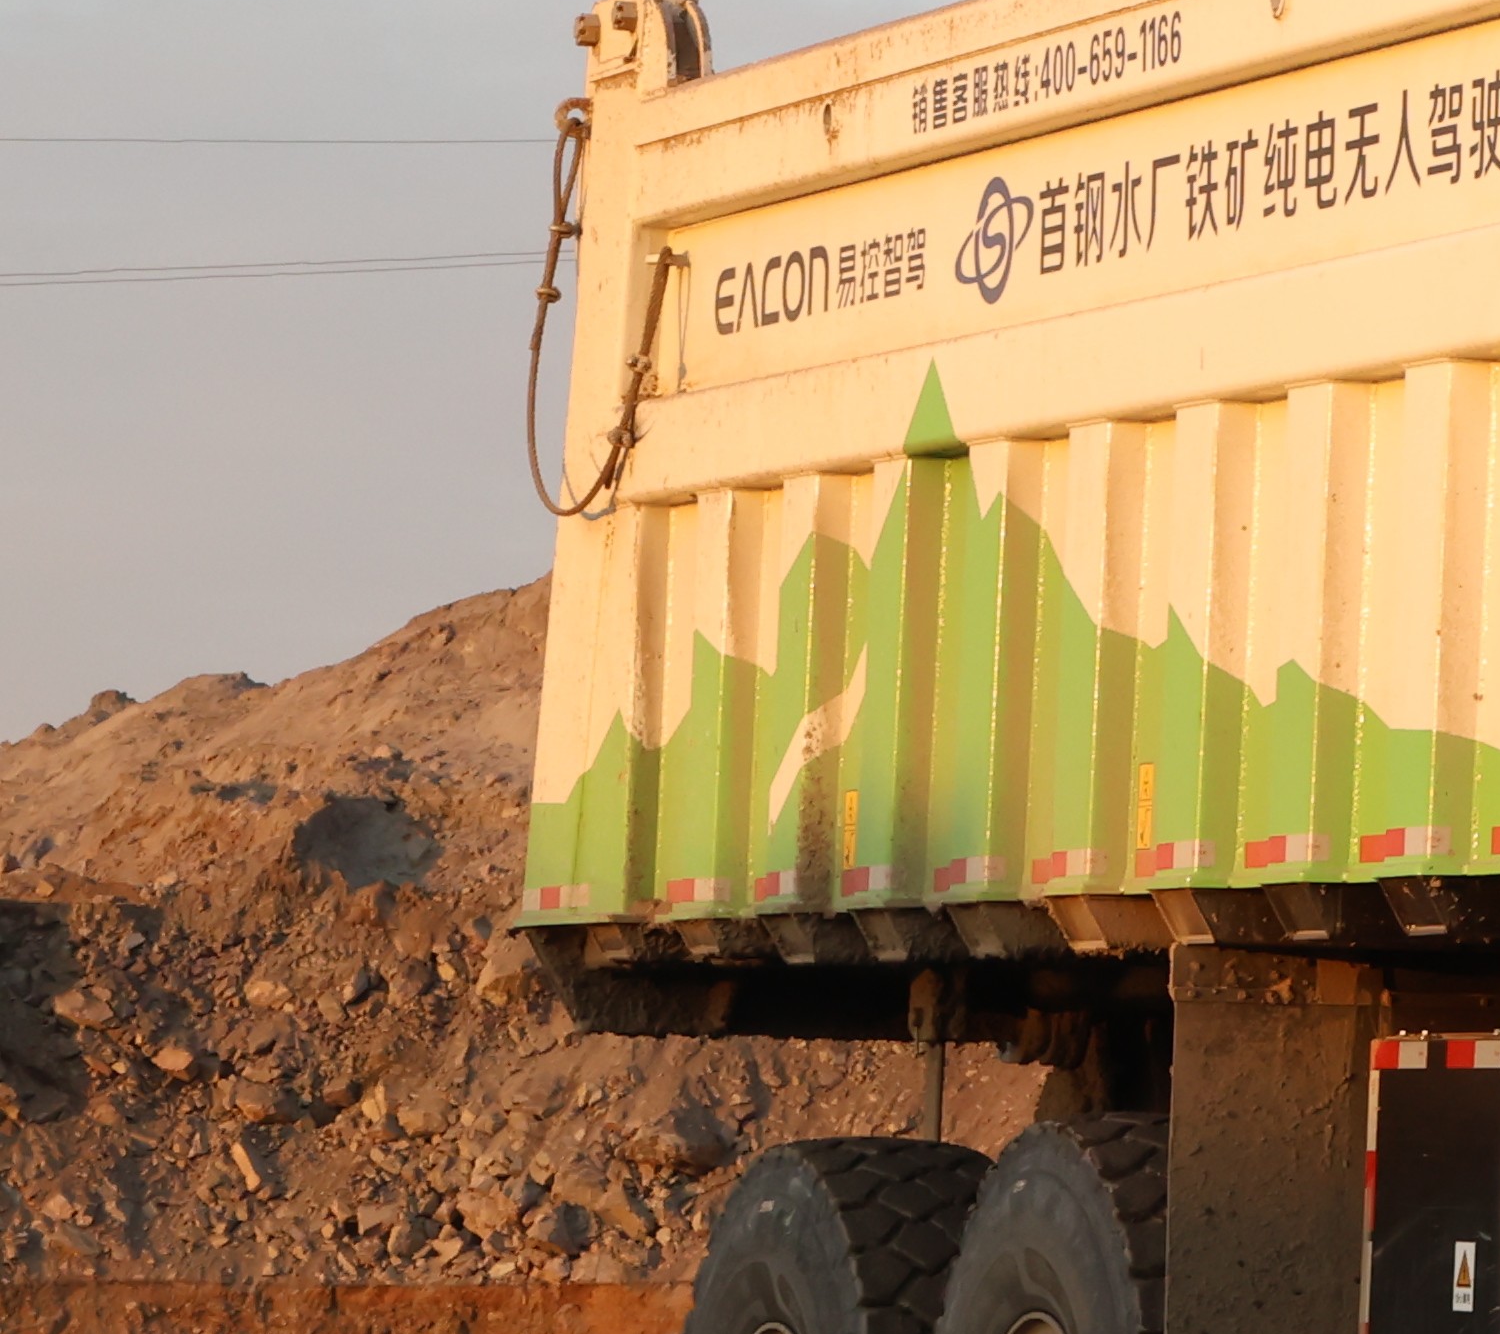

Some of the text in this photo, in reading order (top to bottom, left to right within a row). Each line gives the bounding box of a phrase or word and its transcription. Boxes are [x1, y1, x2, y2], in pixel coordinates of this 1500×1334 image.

[715, 245, 829, 335] EACON
[836, 227, 926, 309] 易控智驾
